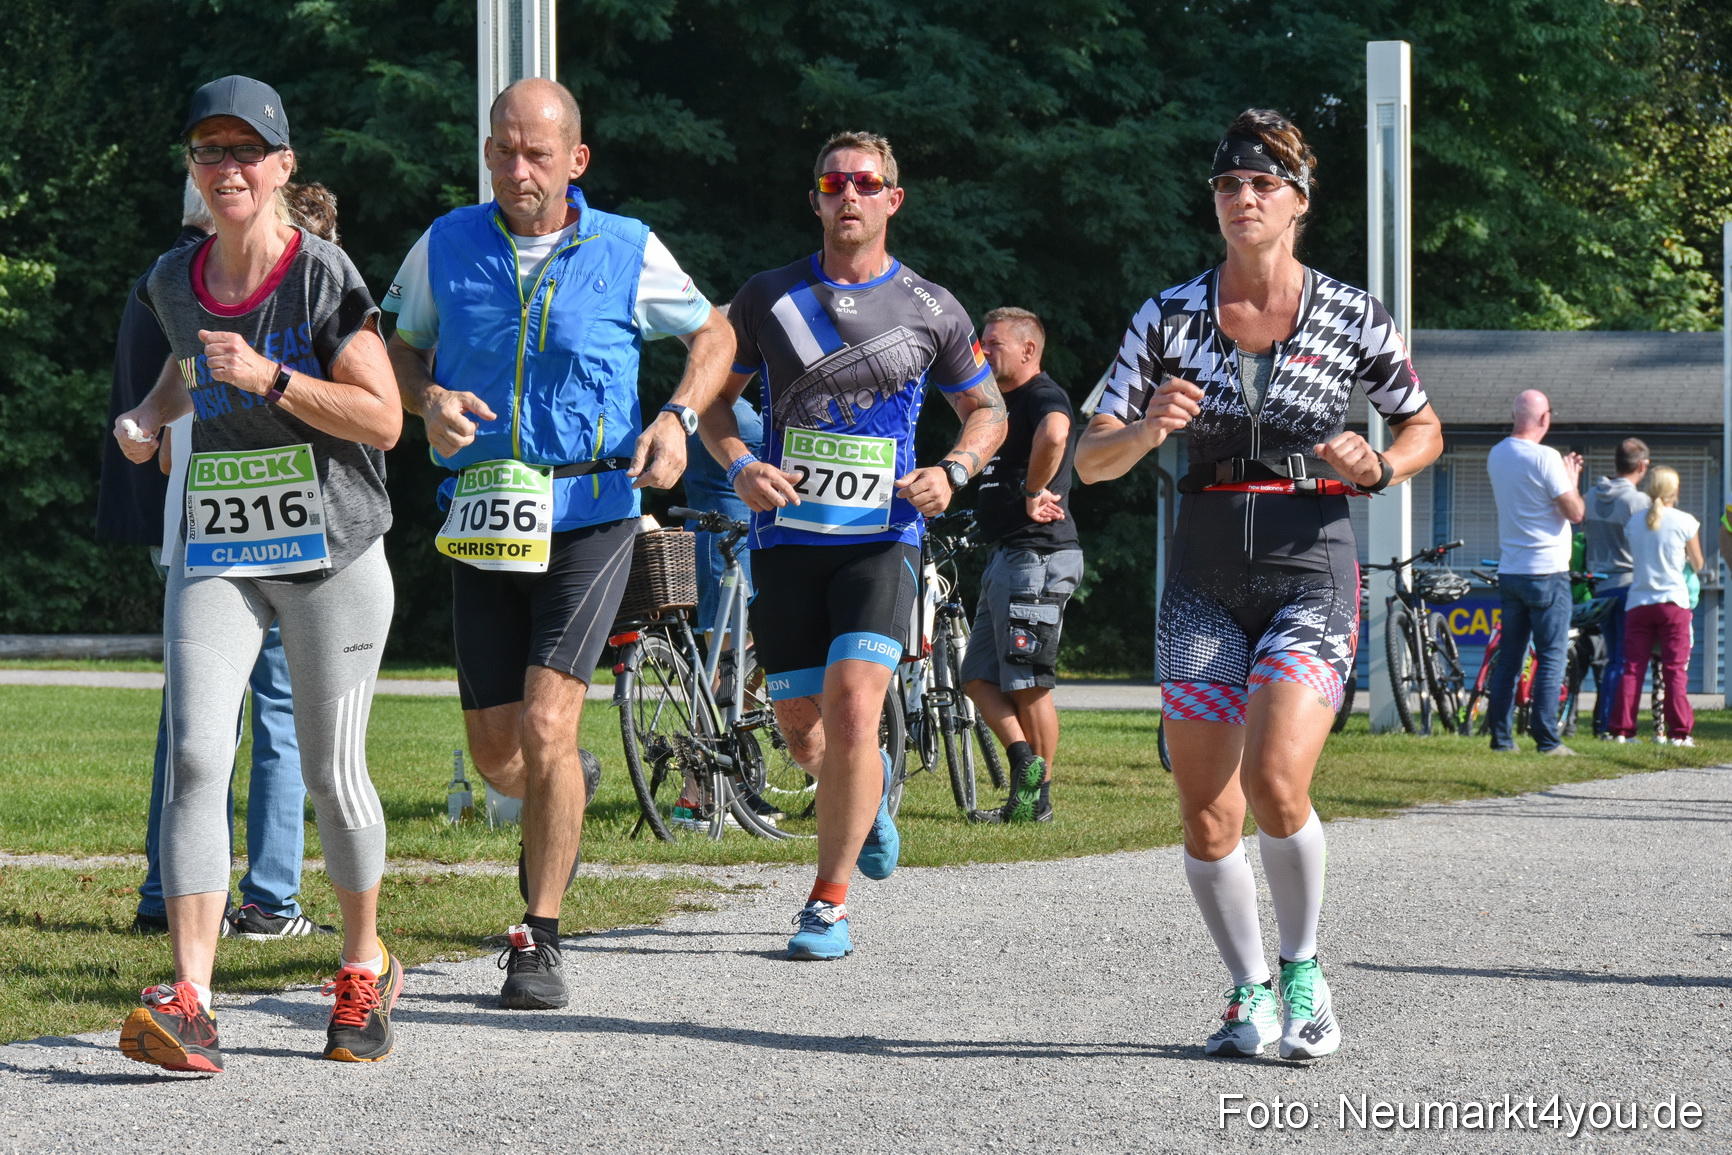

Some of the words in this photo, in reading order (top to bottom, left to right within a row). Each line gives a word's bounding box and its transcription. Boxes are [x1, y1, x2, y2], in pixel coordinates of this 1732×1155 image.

[836, 307, 858, 315] artiva
[913, 286, 943, 316] GROH
[791, 432, 886, 465] BOCK
[195, 451, 304, 486] BOCK
[461, 464, 540, 493] BOCK
[793, 465, 880, 502] 2707
[200, 490, 308, 535] 2316
[460, 499, 537, 532] 1056
[211, 542, 302, 563] CLAUDIA
[447, 542, 532, 557] CHRISTOF
[343, 643, 373, 653] adidas
[858, 639, 901, 664] FUSION
